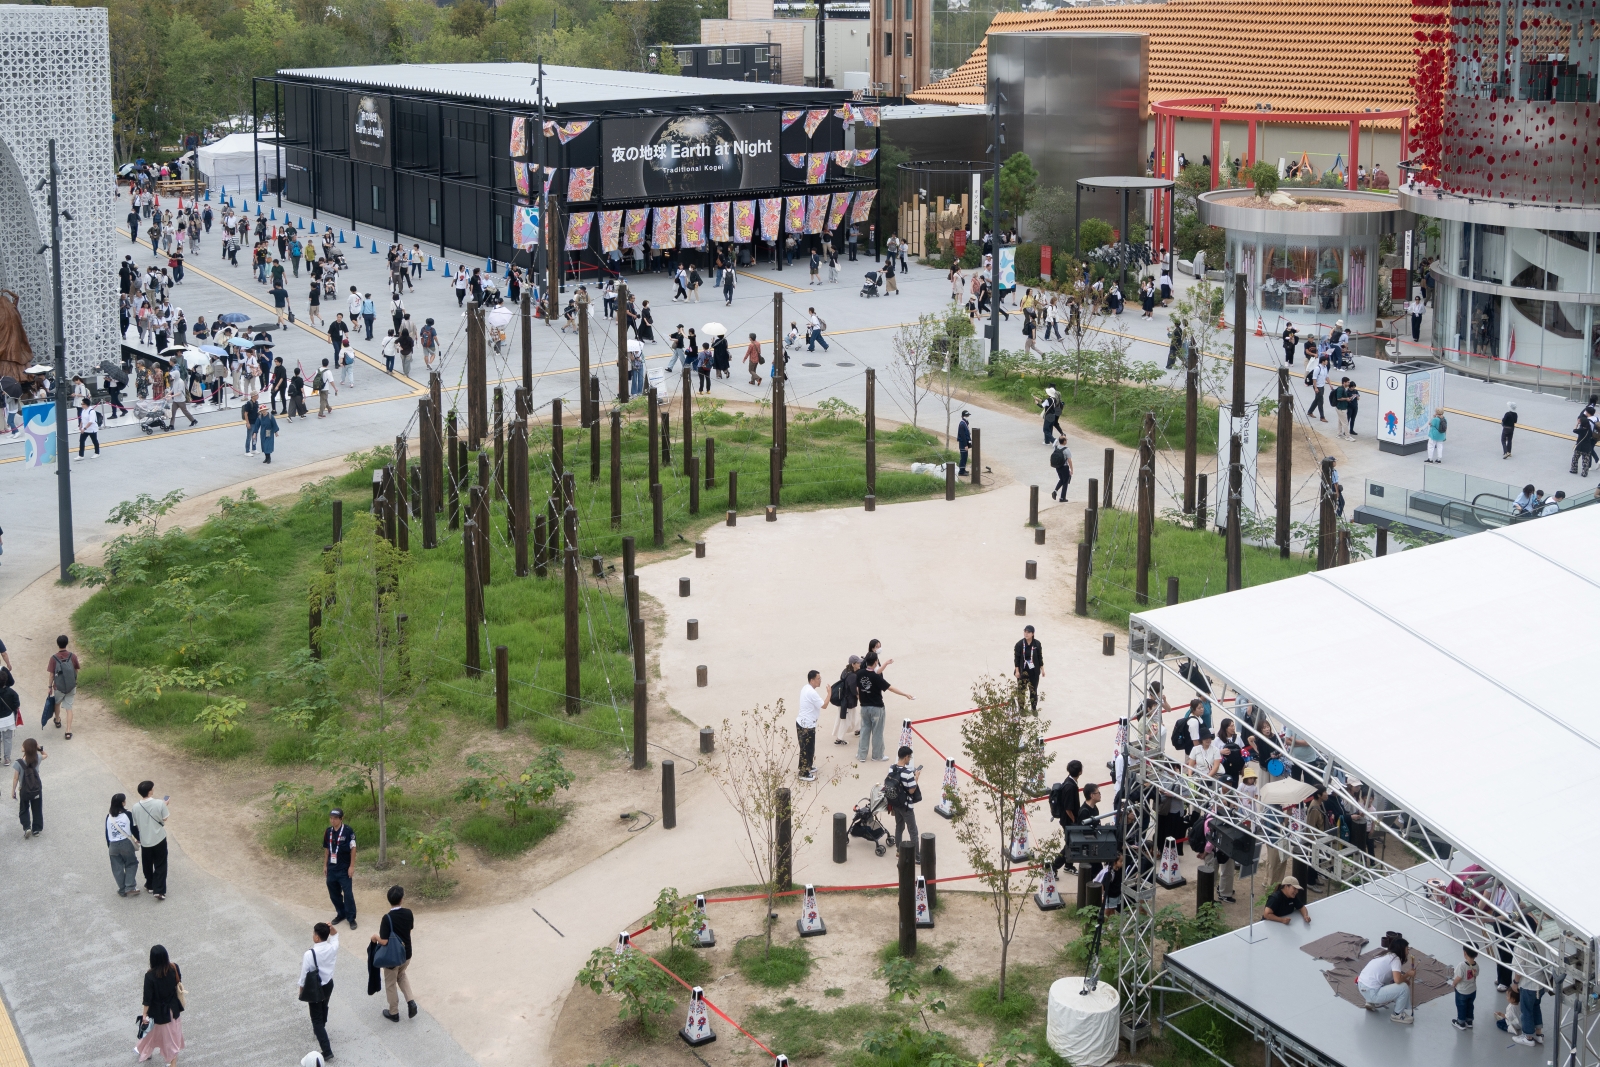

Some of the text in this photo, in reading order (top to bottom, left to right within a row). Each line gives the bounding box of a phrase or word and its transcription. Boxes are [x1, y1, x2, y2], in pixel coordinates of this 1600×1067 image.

[356, 124, 367, 134] Earth
[373, 127, 384, 138] Night
[611, 139, 773, 163] 夜の地球 Earth at Night
[663, 163, 725, 174] Traditional Kogei
